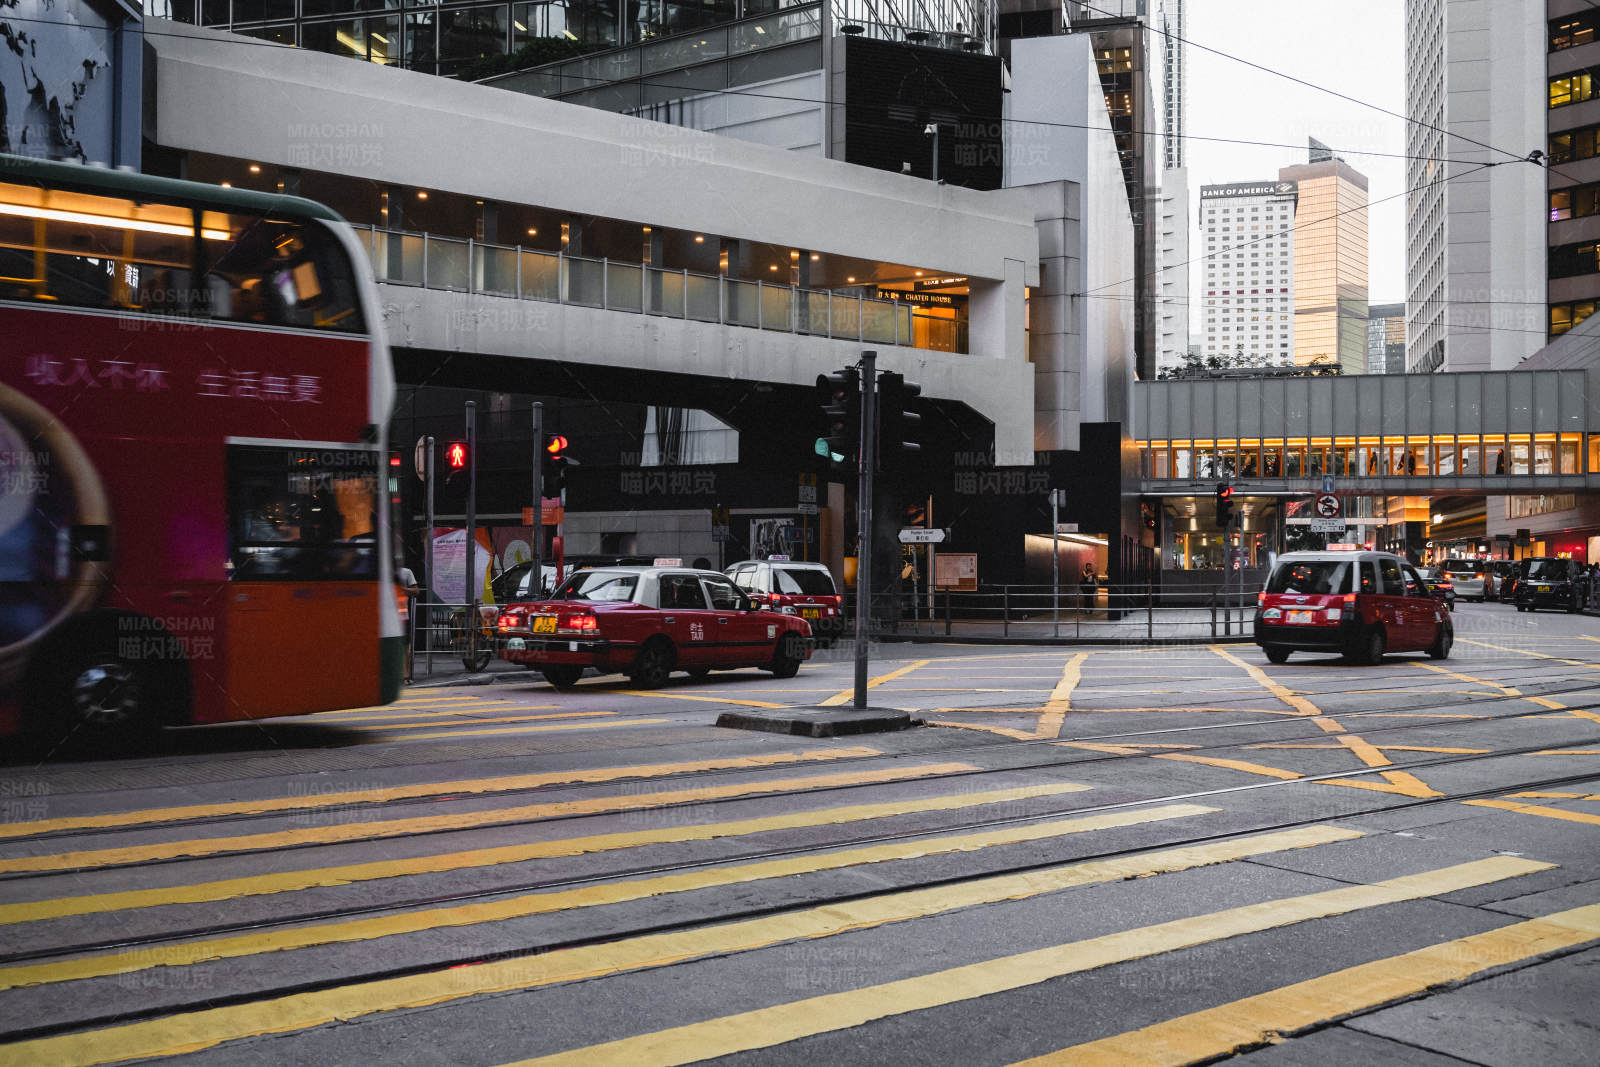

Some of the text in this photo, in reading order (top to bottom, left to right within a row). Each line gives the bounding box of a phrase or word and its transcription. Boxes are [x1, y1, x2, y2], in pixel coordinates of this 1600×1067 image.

[1238, 187, 1274, 195] AMERICA
[905, 293, 929, 302] CHATER
[930, 296, 951, 304] HOUSE
[690, 631, 704, 640] TAXI
